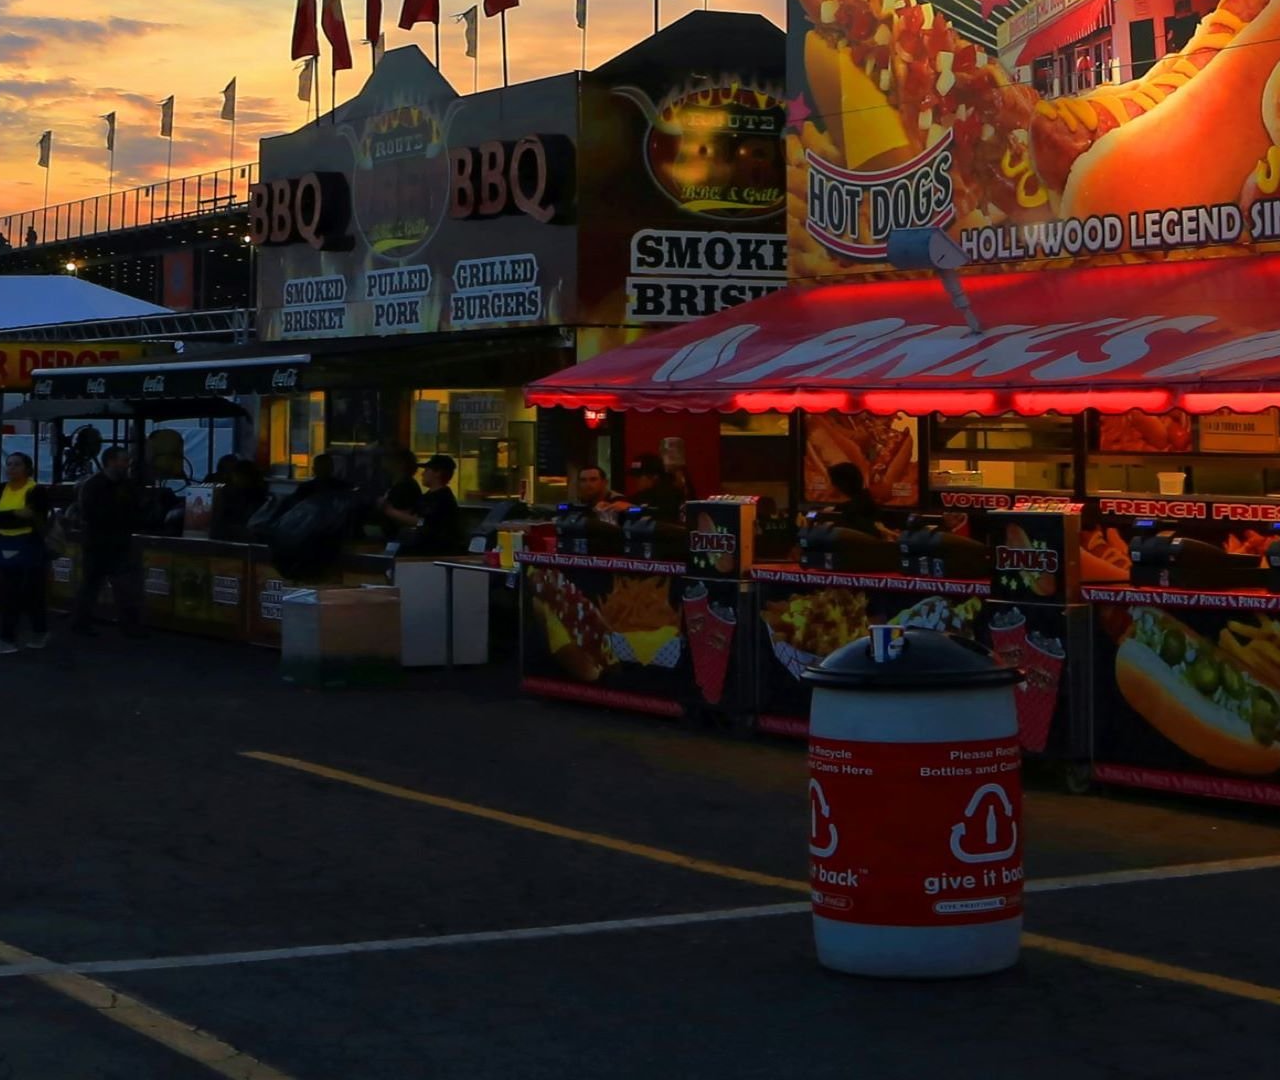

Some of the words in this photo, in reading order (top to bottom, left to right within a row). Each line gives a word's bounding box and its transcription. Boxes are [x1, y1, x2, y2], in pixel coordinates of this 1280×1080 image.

[375, 135, 424, 158] ROUTE
[450, 135, 555, 224] BBQ
[808, 168, 862, 240] HOT
[871, 151, 953, 240] DOGS
[249, 172, 325, 251] BBQ
[961, 214, 1122, 263] HOLLYWOOD
[1128, 203, 1241, 248] LEGEND
[367, 269, 429, 296] PULLED
[456, 258, 535, 289] GRILLED
[286, 279, 344, 305] SMOKED
[375, 301, 419, 327] PORK
[452, 290, 540, 321] BURGERS
[284, 309, 345, 333] BRISKET
[719, 315, 1217, 384] PINK'S
[939, 491, 1011, 510] VOTED
[1098, 499, 1204, 519] FRENCH
[688, 530, 737, 553] PINK'S
[994, 544, 1059, 573] PINK'S
[949, 749, 993, 761] Please
[842, 765, 873, 776] Here
[919, 766, 972, 777] Bottles
[975, 763, 998, 775] and
[819, 869, 858, 888] back
[923, 872, 976, 895] give
[983, 869, 998, 887] it
[1001, 867, 1023, 885] bac
